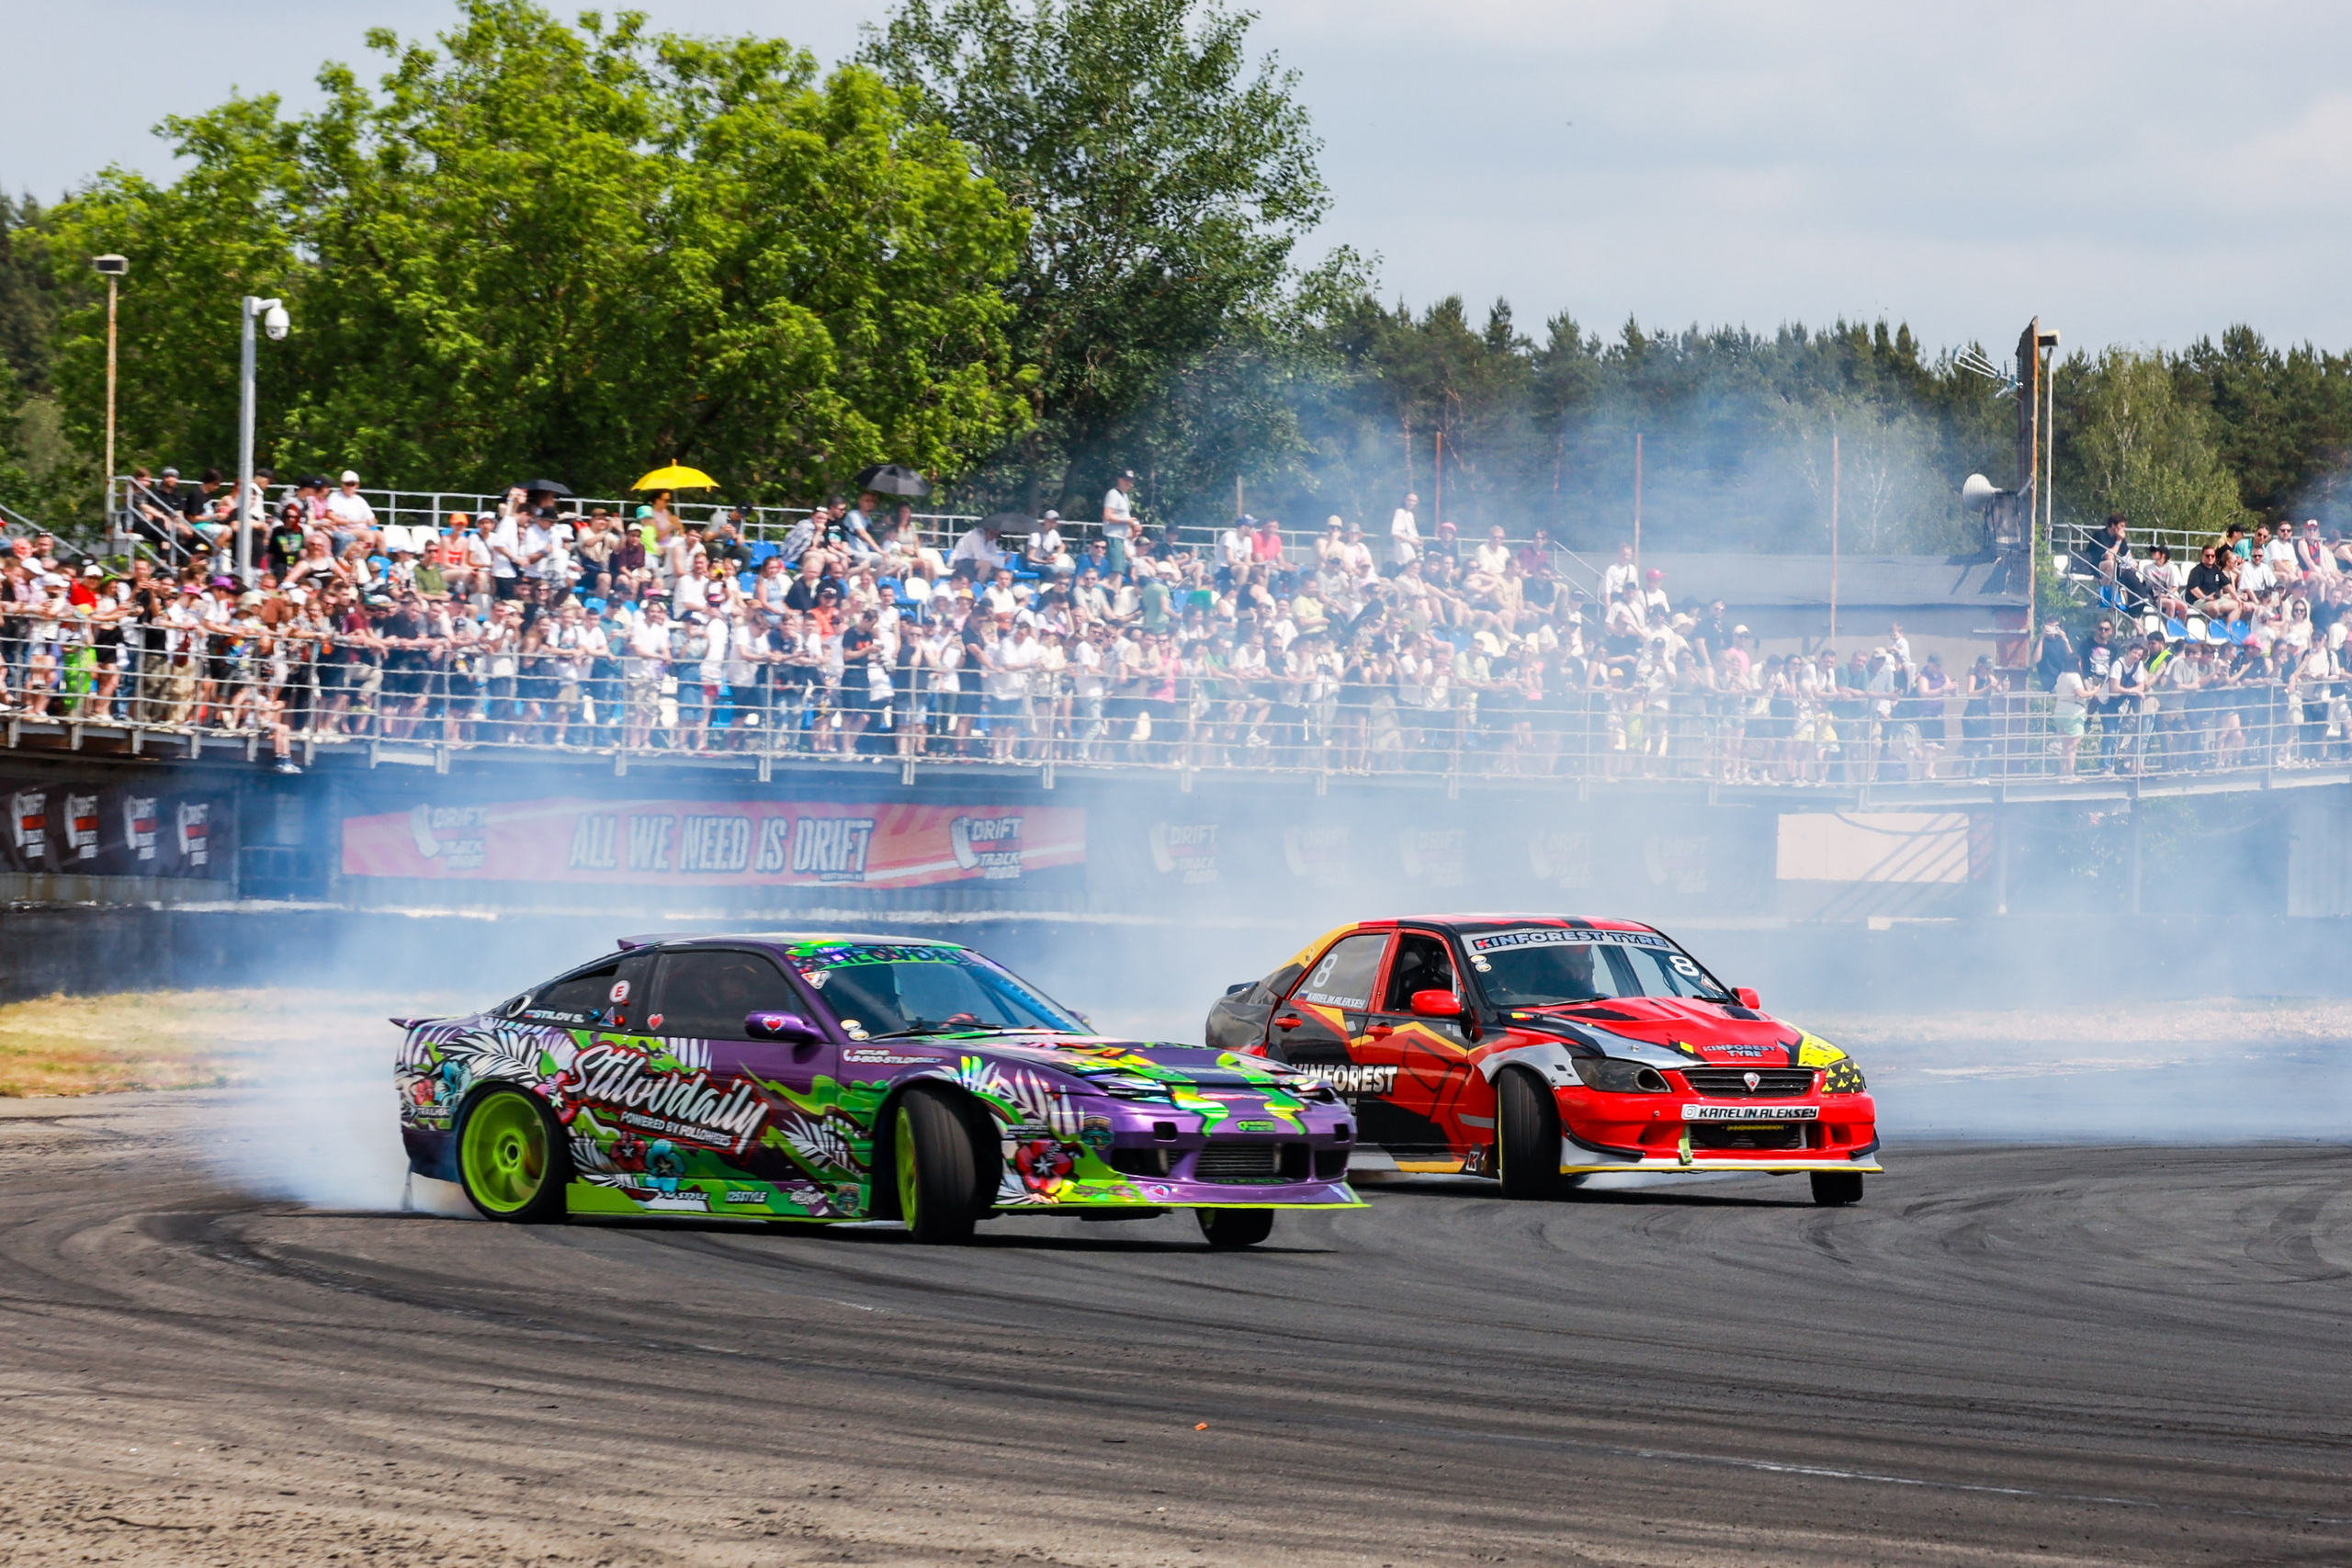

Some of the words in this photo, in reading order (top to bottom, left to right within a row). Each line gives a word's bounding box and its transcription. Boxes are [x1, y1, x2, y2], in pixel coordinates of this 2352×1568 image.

[433, 807, 487, 829] DRIFT
[971, 817, 1023, 840] DRIFT
[569, 815, 616, 869] ALL
[628, 815, 675, 870] WE
[679, 816, 752, 872] NEED
[755, 817, 789, 873] IS
[793, 818, 876, 873] DRIFT
[1170, 824, 1218, 845] DRIFT
[1418, 829, 1467, 849] DRIFT
[1548, 831, 1595, 852] DRIFT
[1661, 836, 1711, 857] DRIFT
[979, 852, 1021, 866] TRACK
[1472, 931, 1604, 951] KINFOREST
[1608, 931, 1670, 948] TYRE
[1312, 953, 1339, 988] 8
[1668, 954, 1700, 976] 8
[615, 986, 625, 998] E
[533, 1009, 573, 1022] STILOV
[1702, 1043, 1776, 1053] KINFOREST
[619, 1111, 665, 1131] POWERED
[664, 1122, 679, 1134] BY
[1698, 1107, 1818, 1119] KARELIN.ALEKSEY
[1465, 1150, 1480, 1172] K
